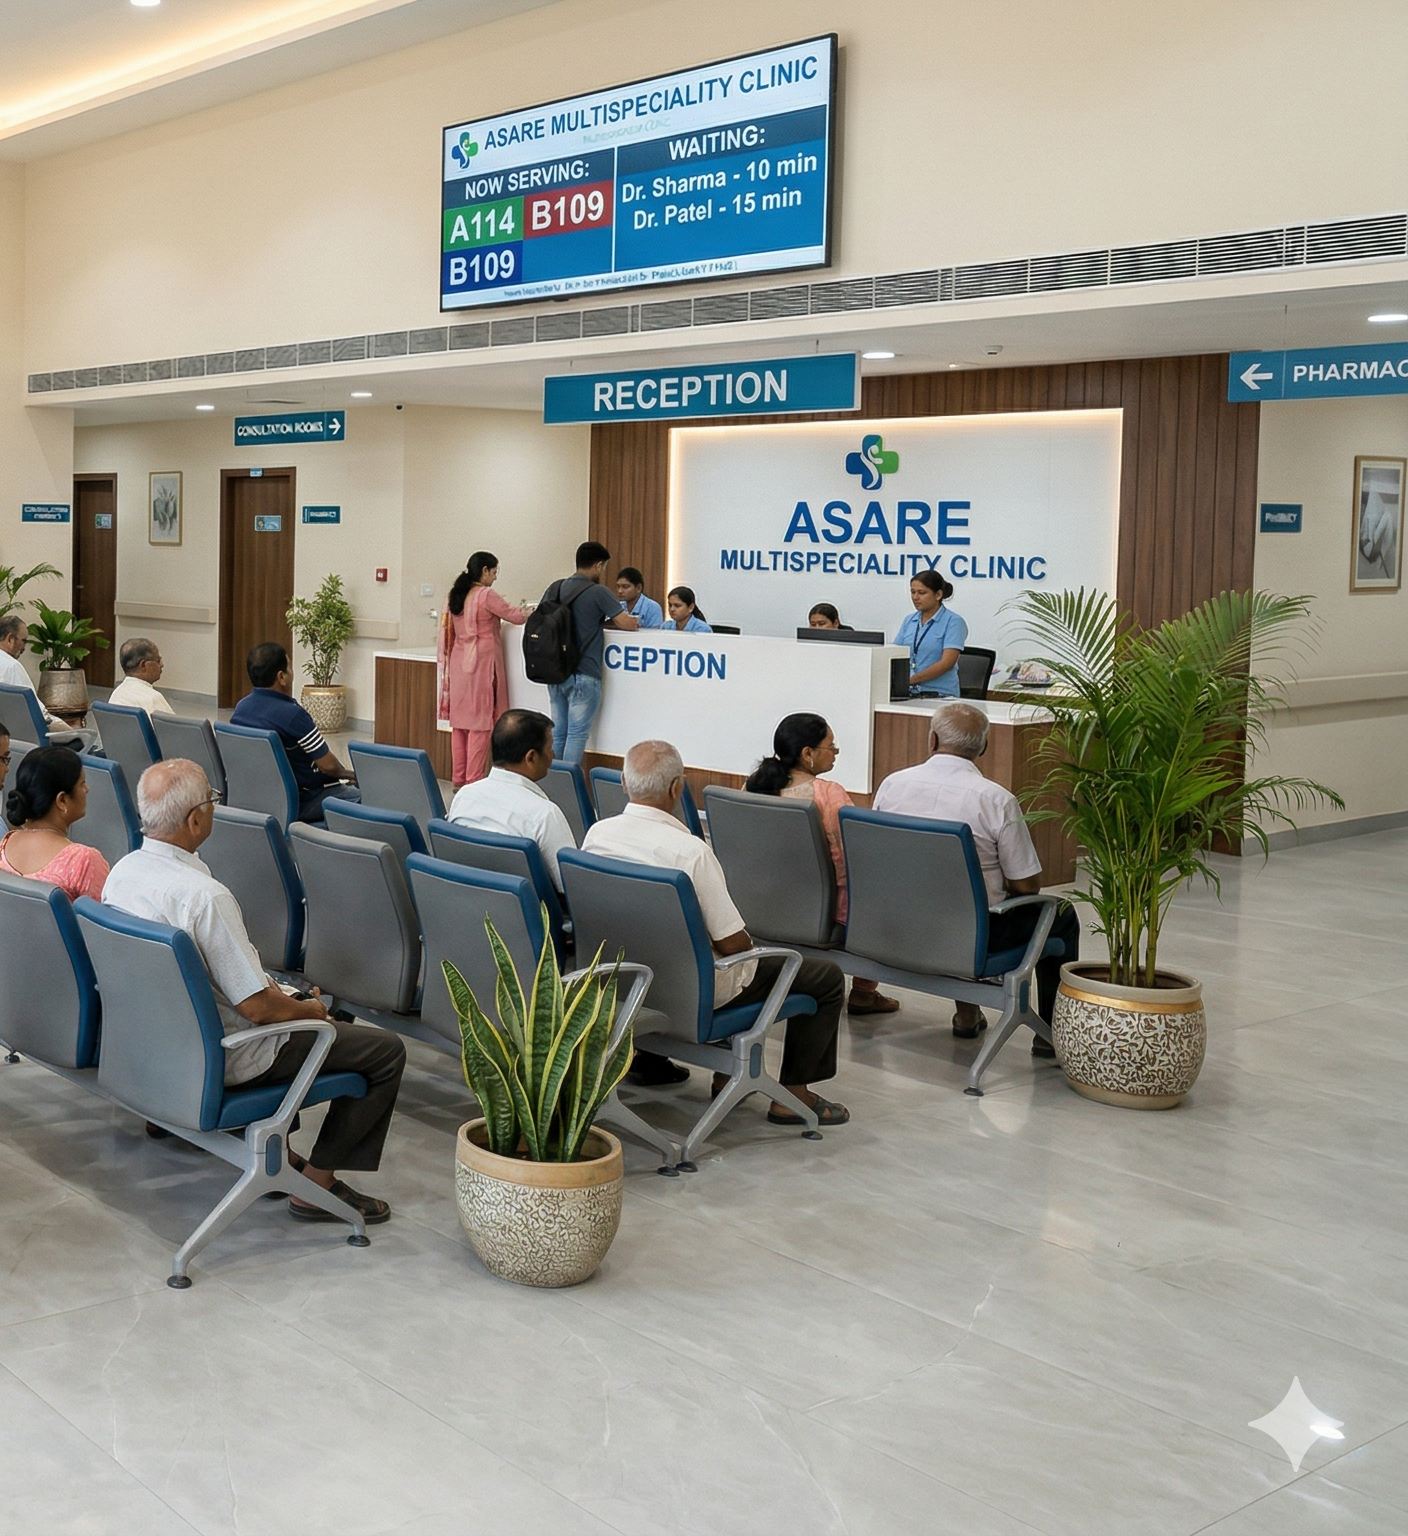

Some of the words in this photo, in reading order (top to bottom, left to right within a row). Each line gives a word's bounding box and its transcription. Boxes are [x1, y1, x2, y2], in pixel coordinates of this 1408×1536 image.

[484, 119, 545, 150] ASARE
[551, 75, 733, 136] MULTISPECIALITY
[739, 56, 818, 93] CLINIC
[669, 125, 766, 161] WAITING:
[465, 176, 504, 200] NOW
[507, 160, 590, 191] SERVING:
[622, 183, 647, 203] Dr.
[652, 171, 726, 197] Sharma
[746, 158, 770, 182] 10
[776, 152, 817, 177] min
[449, 205, 515, 244] A114
[532, 190, 604, 231] B109
[633, 210, 659, 230] Dr.
[665, 199, 712, 226] Patel
[732, 192, 756, 215] 15
[762, 186, 802, 211] min
[449, 249, 515, 286] B109
[594, 369, 788, 412] RECEPTION
[1293, 359, 1408, 383] PHARMAC
[783, 500, 971, 546] ASARE
[720, 549, 942, 576] MULTISPECIALITY
[949, 555, 1047, 580] CLINIC
[604, 644, 726, 680] CEPTION
